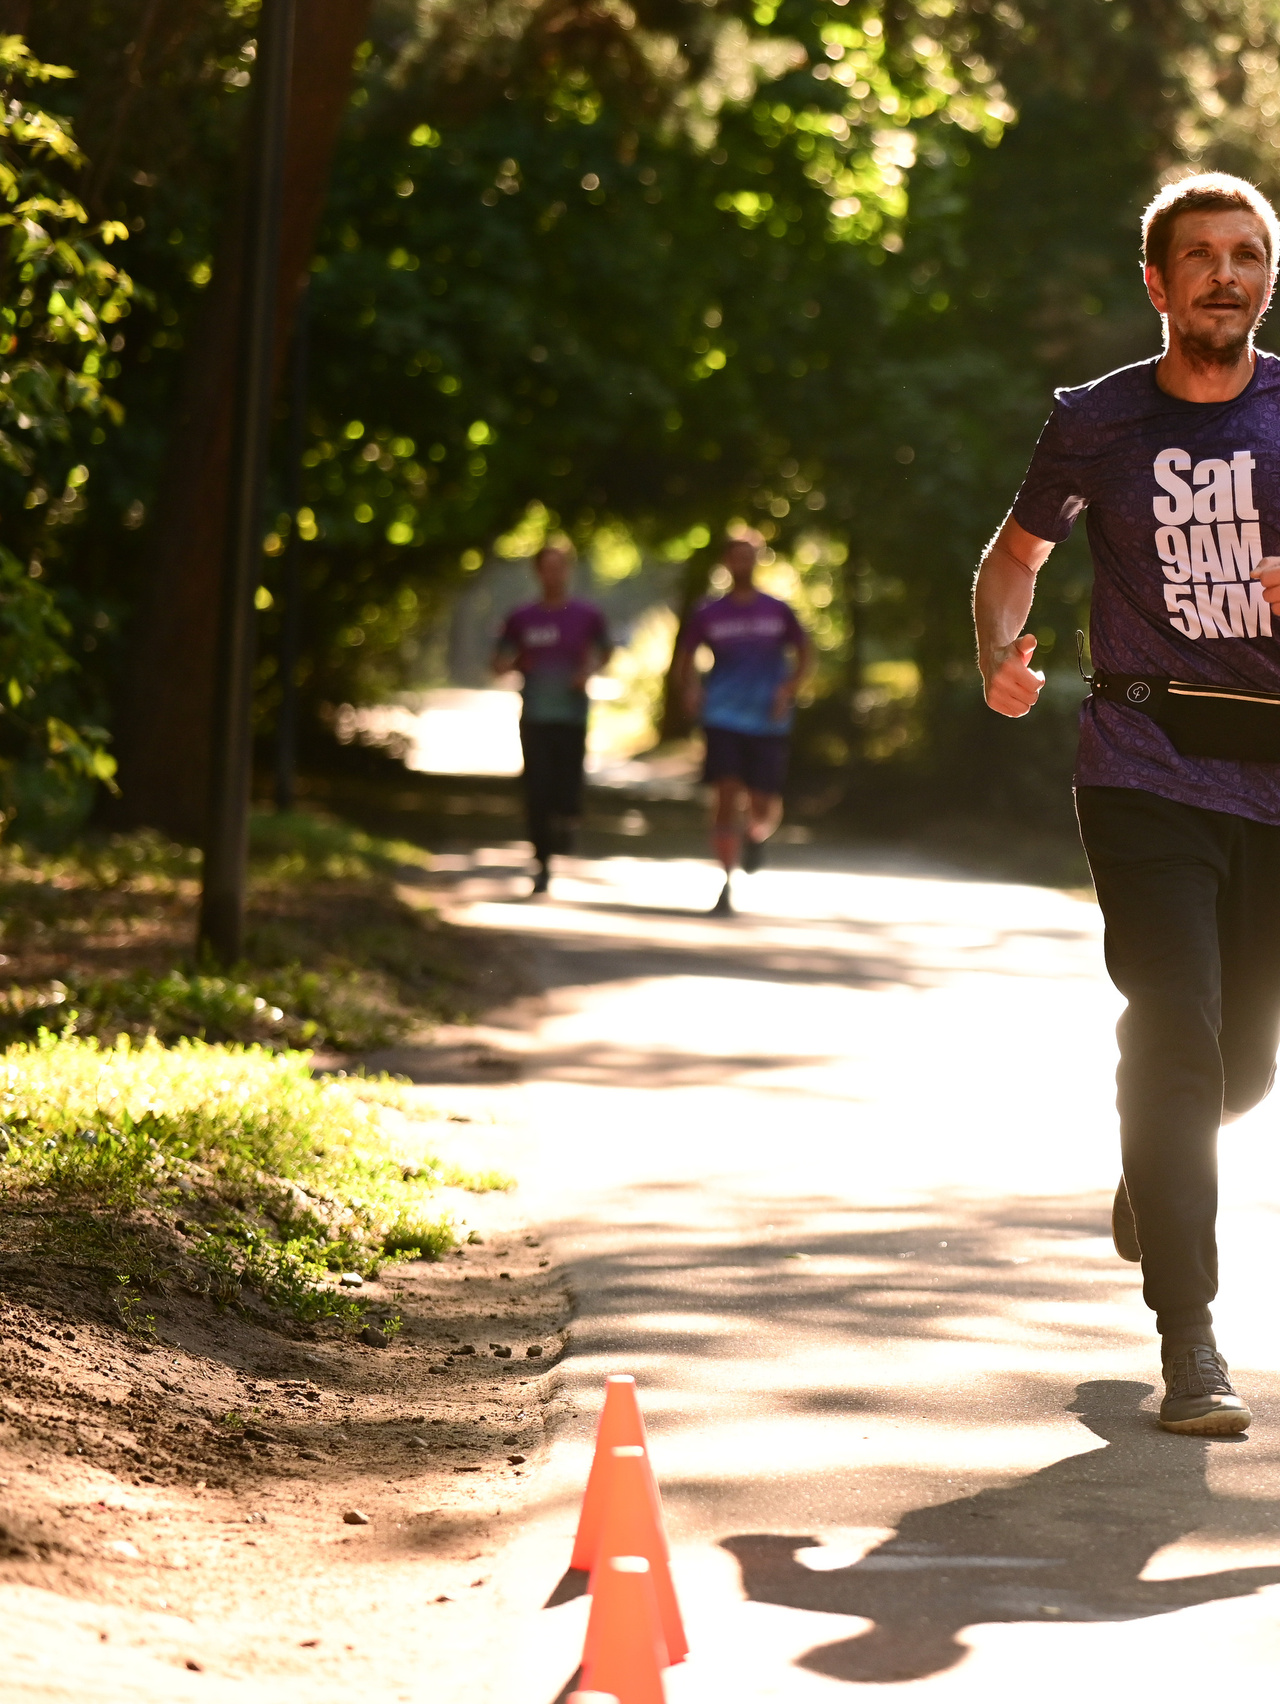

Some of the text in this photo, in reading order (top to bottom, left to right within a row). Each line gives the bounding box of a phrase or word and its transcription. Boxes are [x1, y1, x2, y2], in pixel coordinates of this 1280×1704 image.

[1153, 448, 1259, 526] Sat
[1155, 523, 1263, 583] 9AM
[1163, 582, 1272, 640] 5KM
